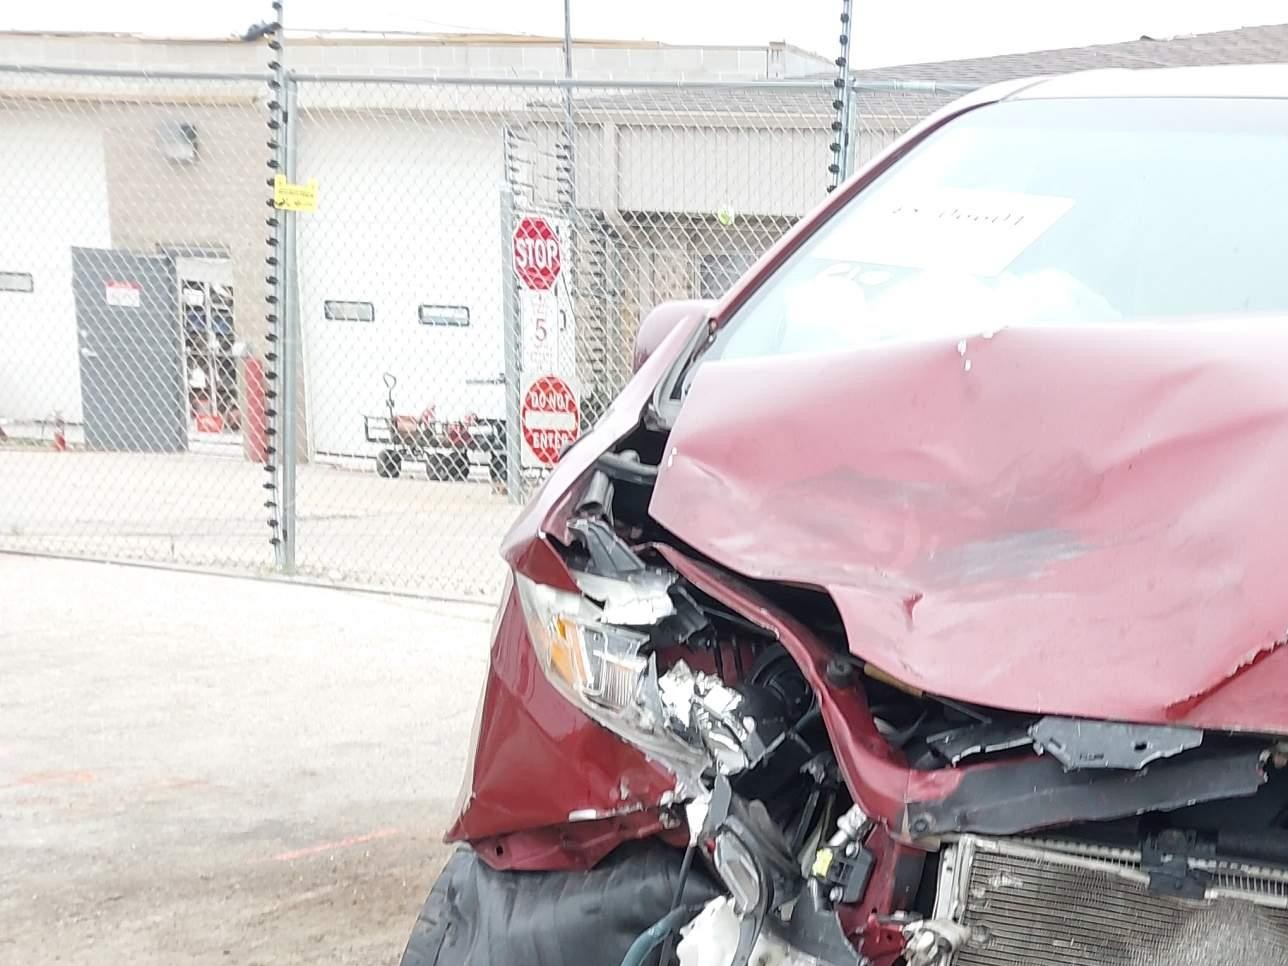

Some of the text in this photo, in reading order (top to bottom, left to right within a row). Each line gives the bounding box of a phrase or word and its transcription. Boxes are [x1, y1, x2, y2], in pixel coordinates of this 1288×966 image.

[514, 238, 559, 269] STOP
[535, 318, 547, 342] 5
[531, 392, 570, 411] DO NOT
